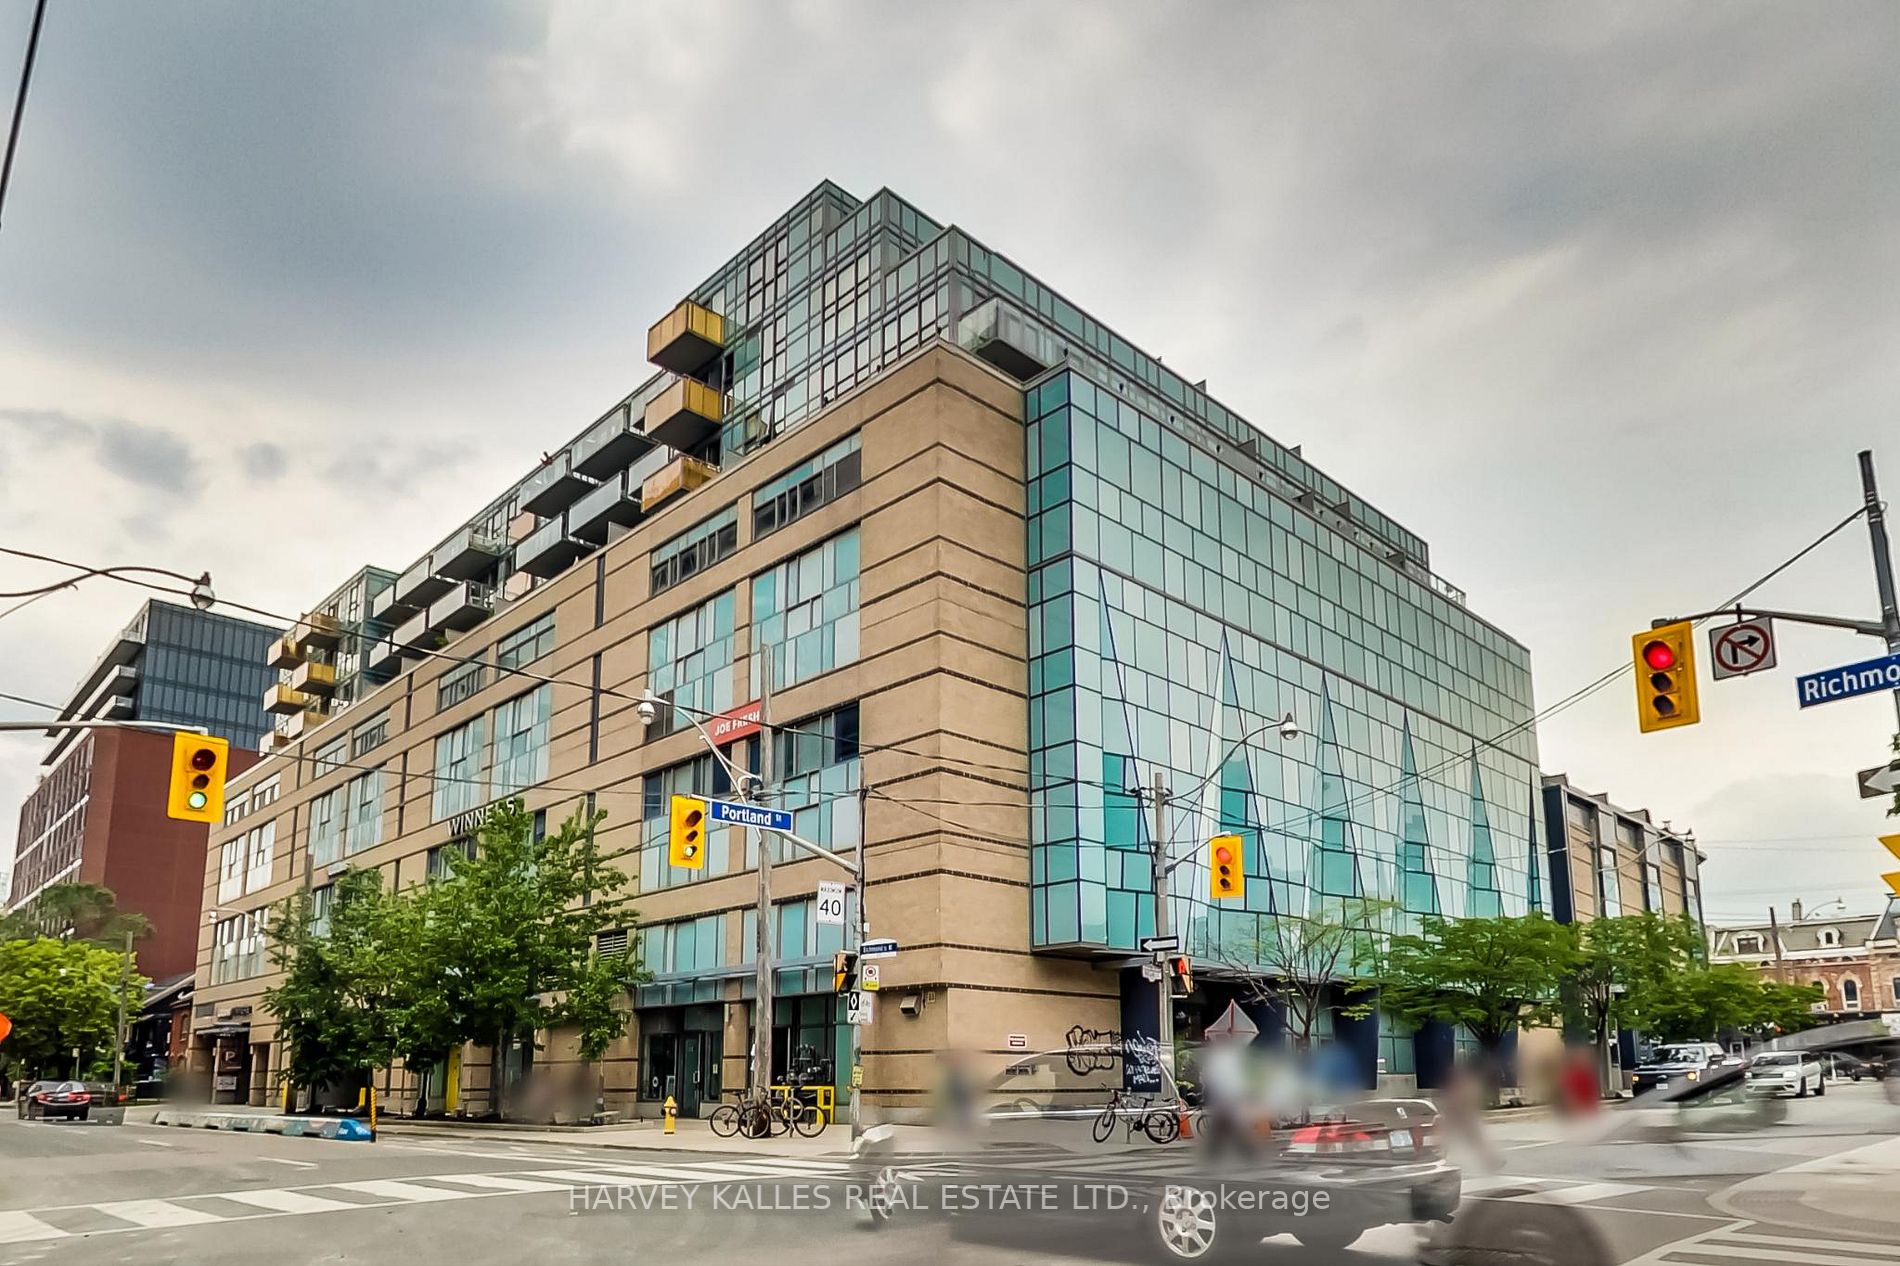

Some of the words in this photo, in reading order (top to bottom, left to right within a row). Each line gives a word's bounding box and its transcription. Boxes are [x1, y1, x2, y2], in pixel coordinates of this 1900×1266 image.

[1803, 663, 1900, 701] Richmo
[714, 721, 731, 736] JOE
[732, 710, 760, 730] FRESH
[721, 804, 772, 826] Portland
[819, 899, 841, 916] 40
[225, 1051, 236, 1062] P
